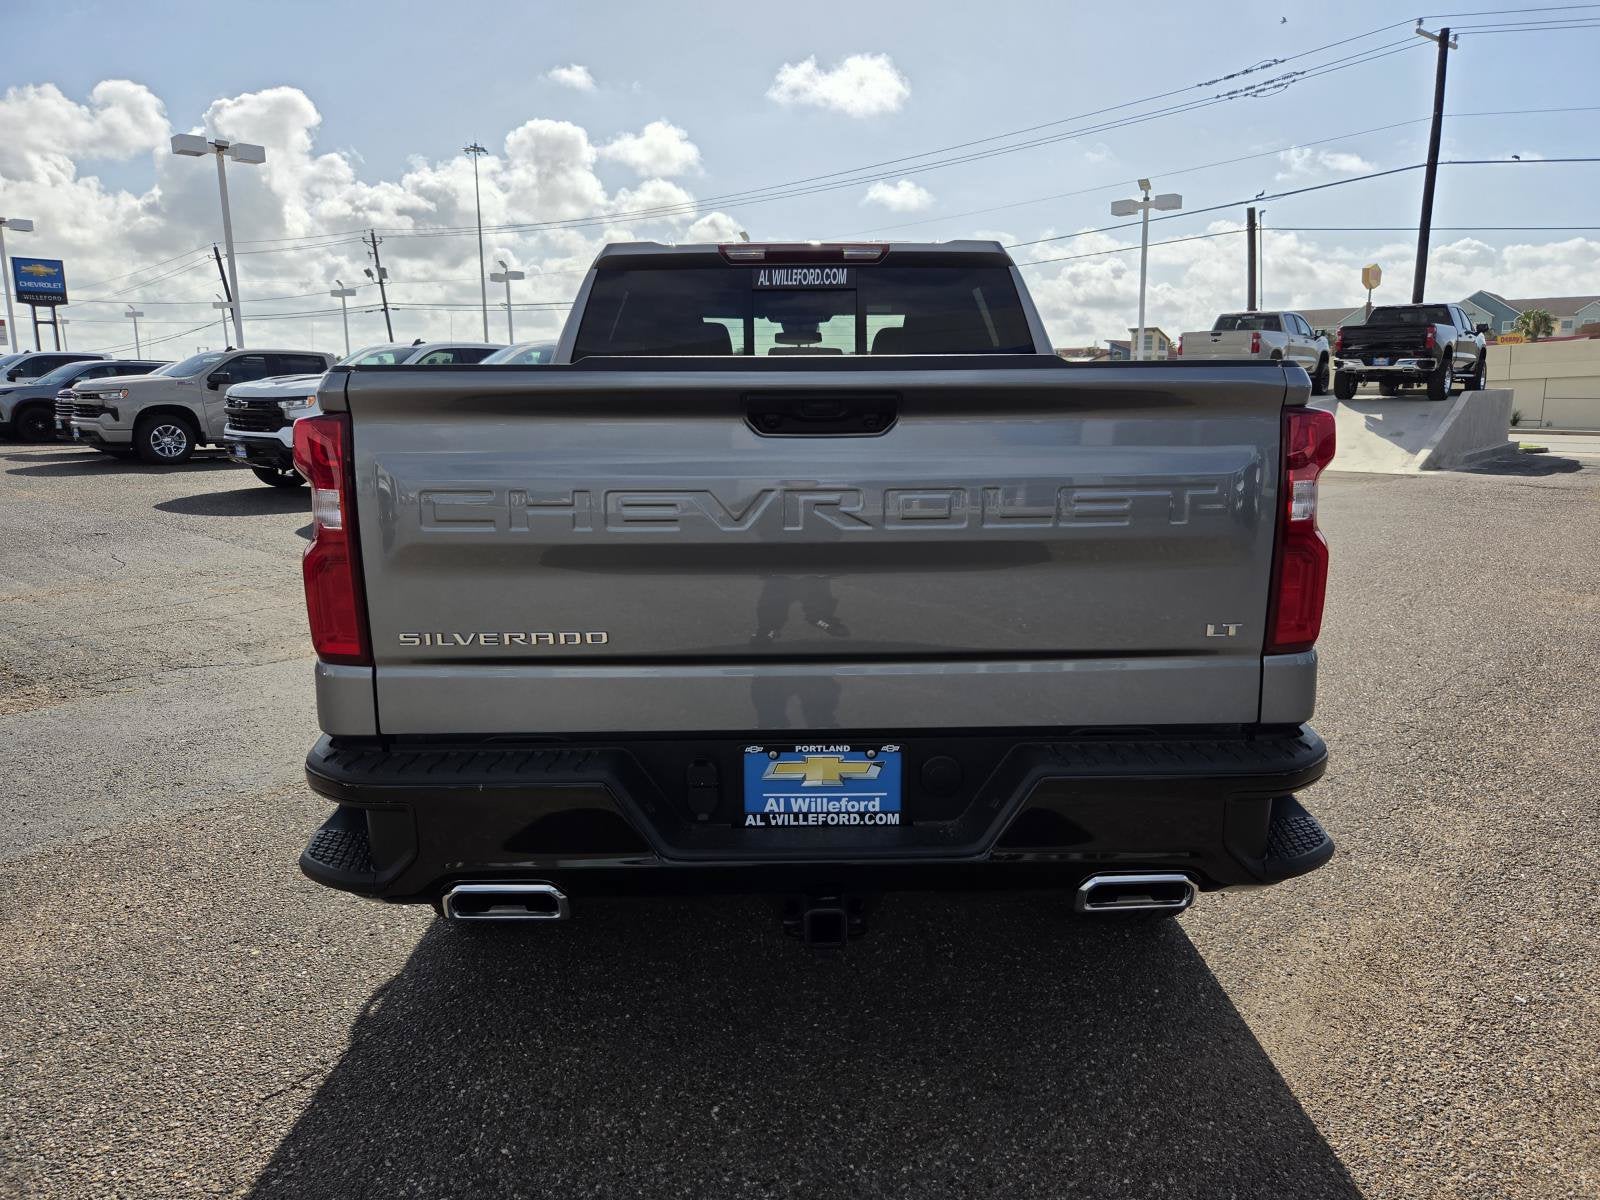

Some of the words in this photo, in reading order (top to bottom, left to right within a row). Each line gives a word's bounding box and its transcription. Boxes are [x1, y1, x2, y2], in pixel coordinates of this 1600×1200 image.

[758, 269, 769, 285] AL
[772, 268, 847, 285] WILLEFORD.COM
[23, 294, 62, 302] WILLEFORD
[418, 484, 1226, 532] CHEVROLET
[1206, 623, 1243, 637] LT
[398, 632, 609, 646] SILVERADO
[795, 745, 851, 753] PORTLAND
[764, 798, 785, 812] Al
[790, 797, 880, 812] Willeford
[745, 814, 765, 826] AL
[770, 813, 900, 826] WILLEFORD.COM
